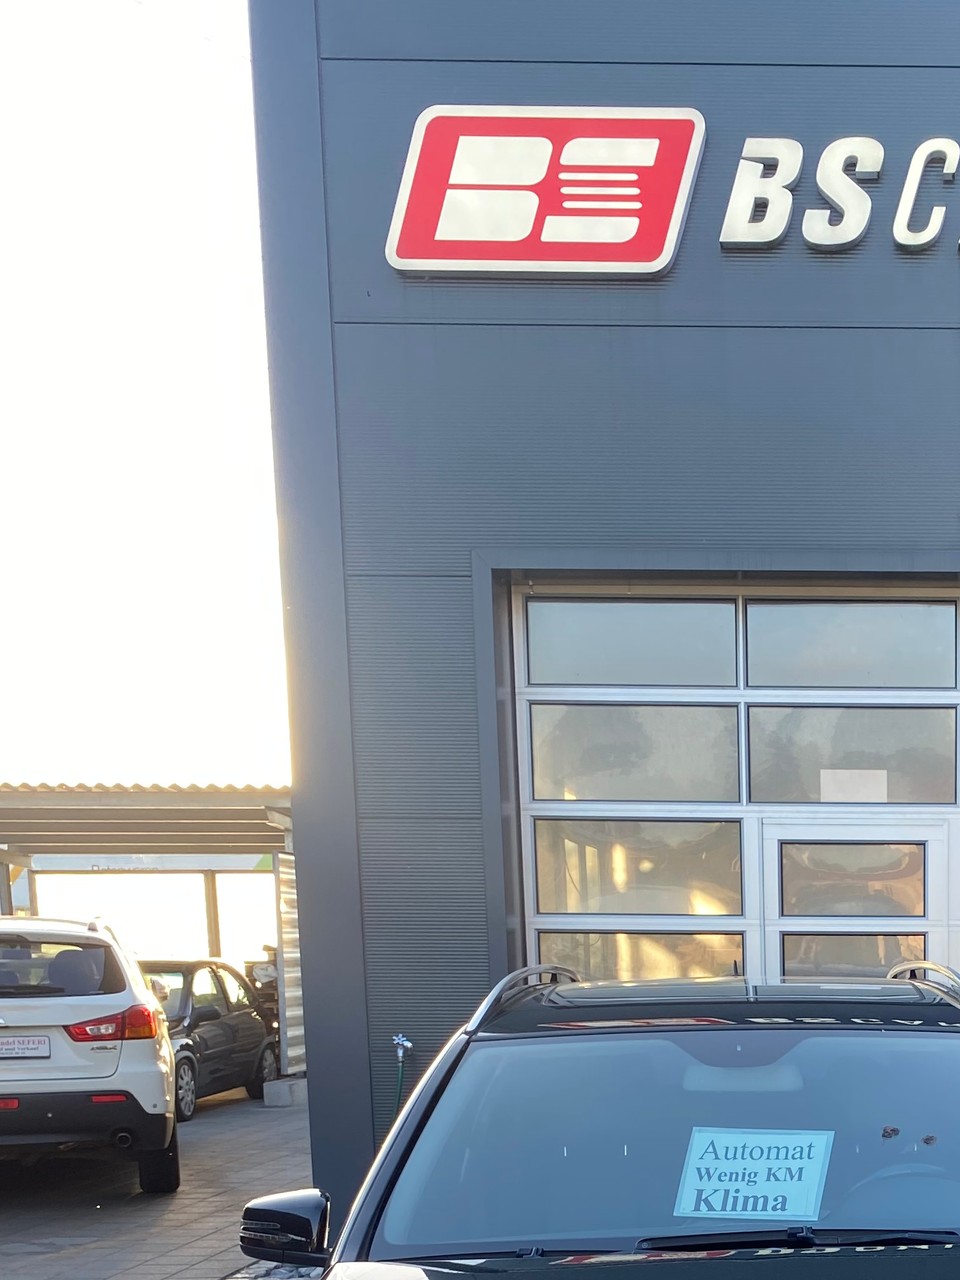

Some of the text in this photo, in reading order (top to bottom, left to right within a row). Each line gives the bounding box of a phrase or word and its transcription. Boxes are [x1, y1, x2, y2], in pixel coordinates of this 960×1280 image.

[698, 1139, 816, 1161] Automat
[695, 1166, 805, 1187] Wenig KM
[690, 1188, 789, 1213] Klima
